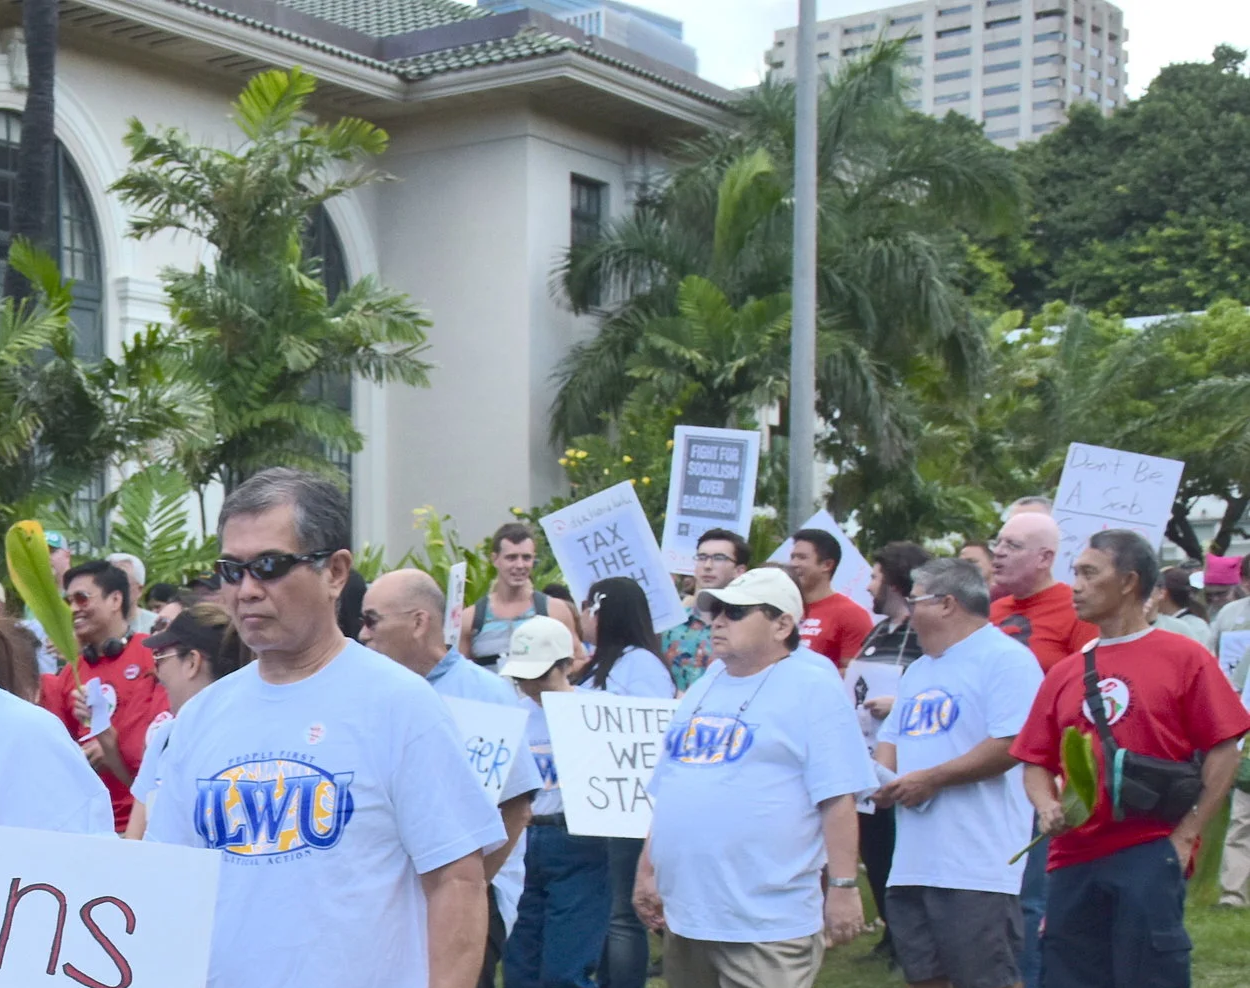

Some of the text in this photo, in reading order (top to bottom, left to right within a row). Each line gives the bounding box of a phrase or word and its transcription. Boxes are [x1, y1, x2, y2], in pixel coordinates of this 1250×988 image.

[690, 444, 740, 462] FIGHT FOR
[687, 461, 740, 479] SOCIALISM
[1134, 460, 1165, 484] Be
[699, 479, 725, 496] OVER
[1066, 481, 1082, 506] A
[577, 523, 624, 555] TAX
[587, 547, 635, 579] THE
[581, 704, 676, 733] UNITE
[280, 751, 316, 763] FIRST
[608, 742, 655, 769] WE
[586, 776, 654, 812] STA
[196, 771, 355, 851] ILWU
